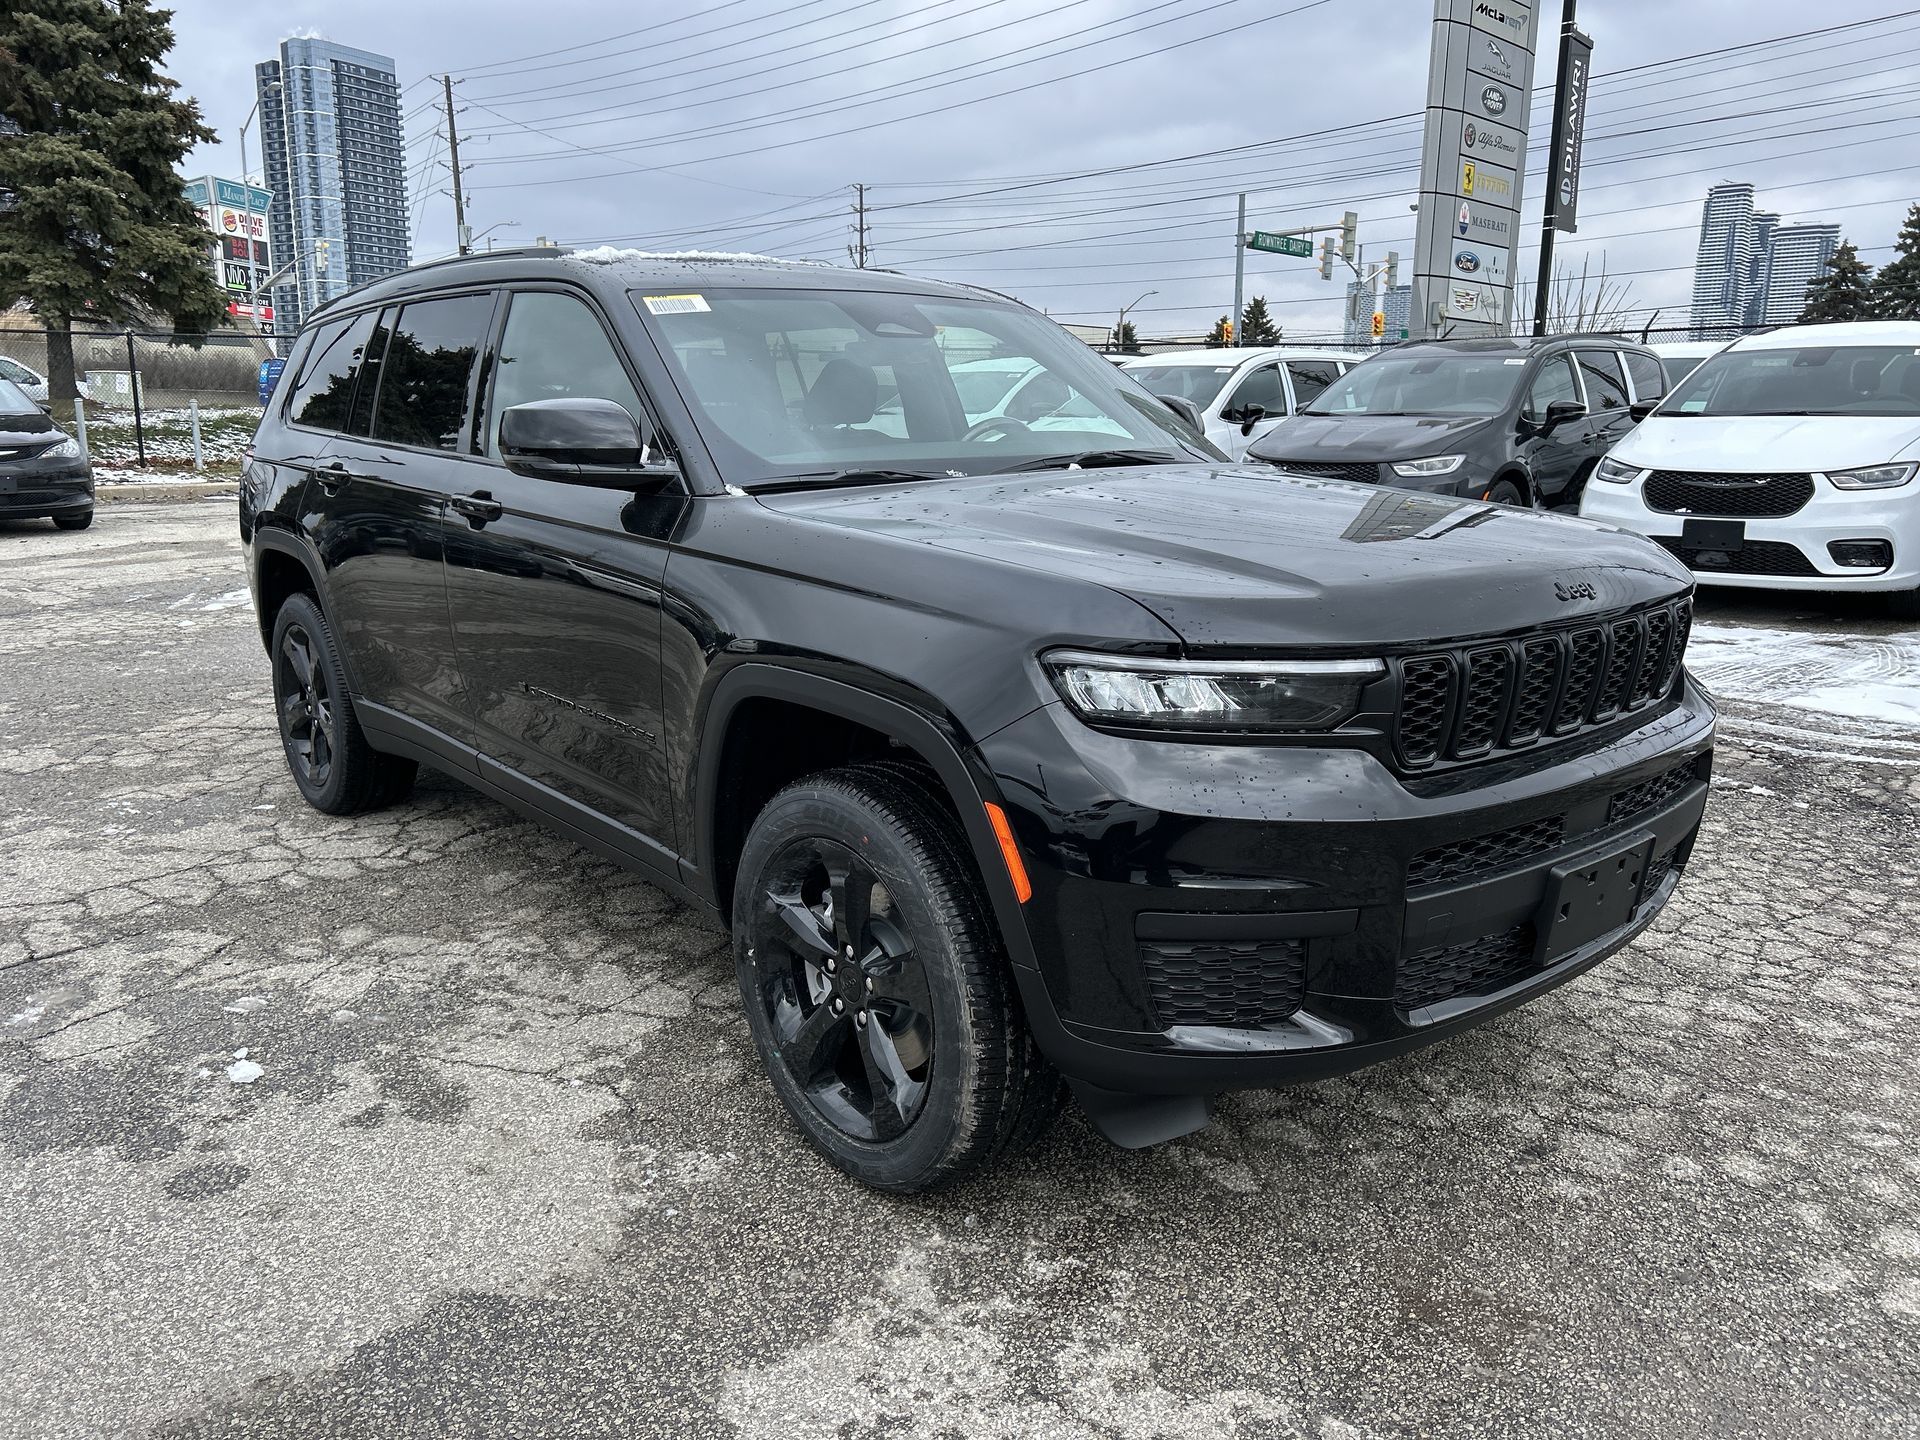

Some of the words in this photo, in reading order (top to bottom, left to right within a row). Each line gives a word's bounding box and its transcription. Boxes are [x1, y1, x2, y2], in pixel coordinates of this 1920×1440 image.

[1475, 2, 1523, 31] McLaren
[1482, 65, 1511, 80] JAGUAR
[1486, 89, 1500, 102] LAND
[1486, 99, 1503, 112] ROVER
[1564, 59, 1582, 173] DILAWRI
[1478, 131, 1494, 149] Alfa
[1493, 135, 1517, 153] Romeo
[238, 214, 264, 227] DIVE
[1471, 216, 1508, 233] MASERATI
[232, 239, 259, 251] BATN
[1258, 234, 1288, 250] ROWNTREE
[1289, 240, 1305, 253] DAIRY
[232, 248, 260, 260] ROUE
[1458, 255, 1476, 270] Ford
[1553, 582, 1597, 601] Jeep
